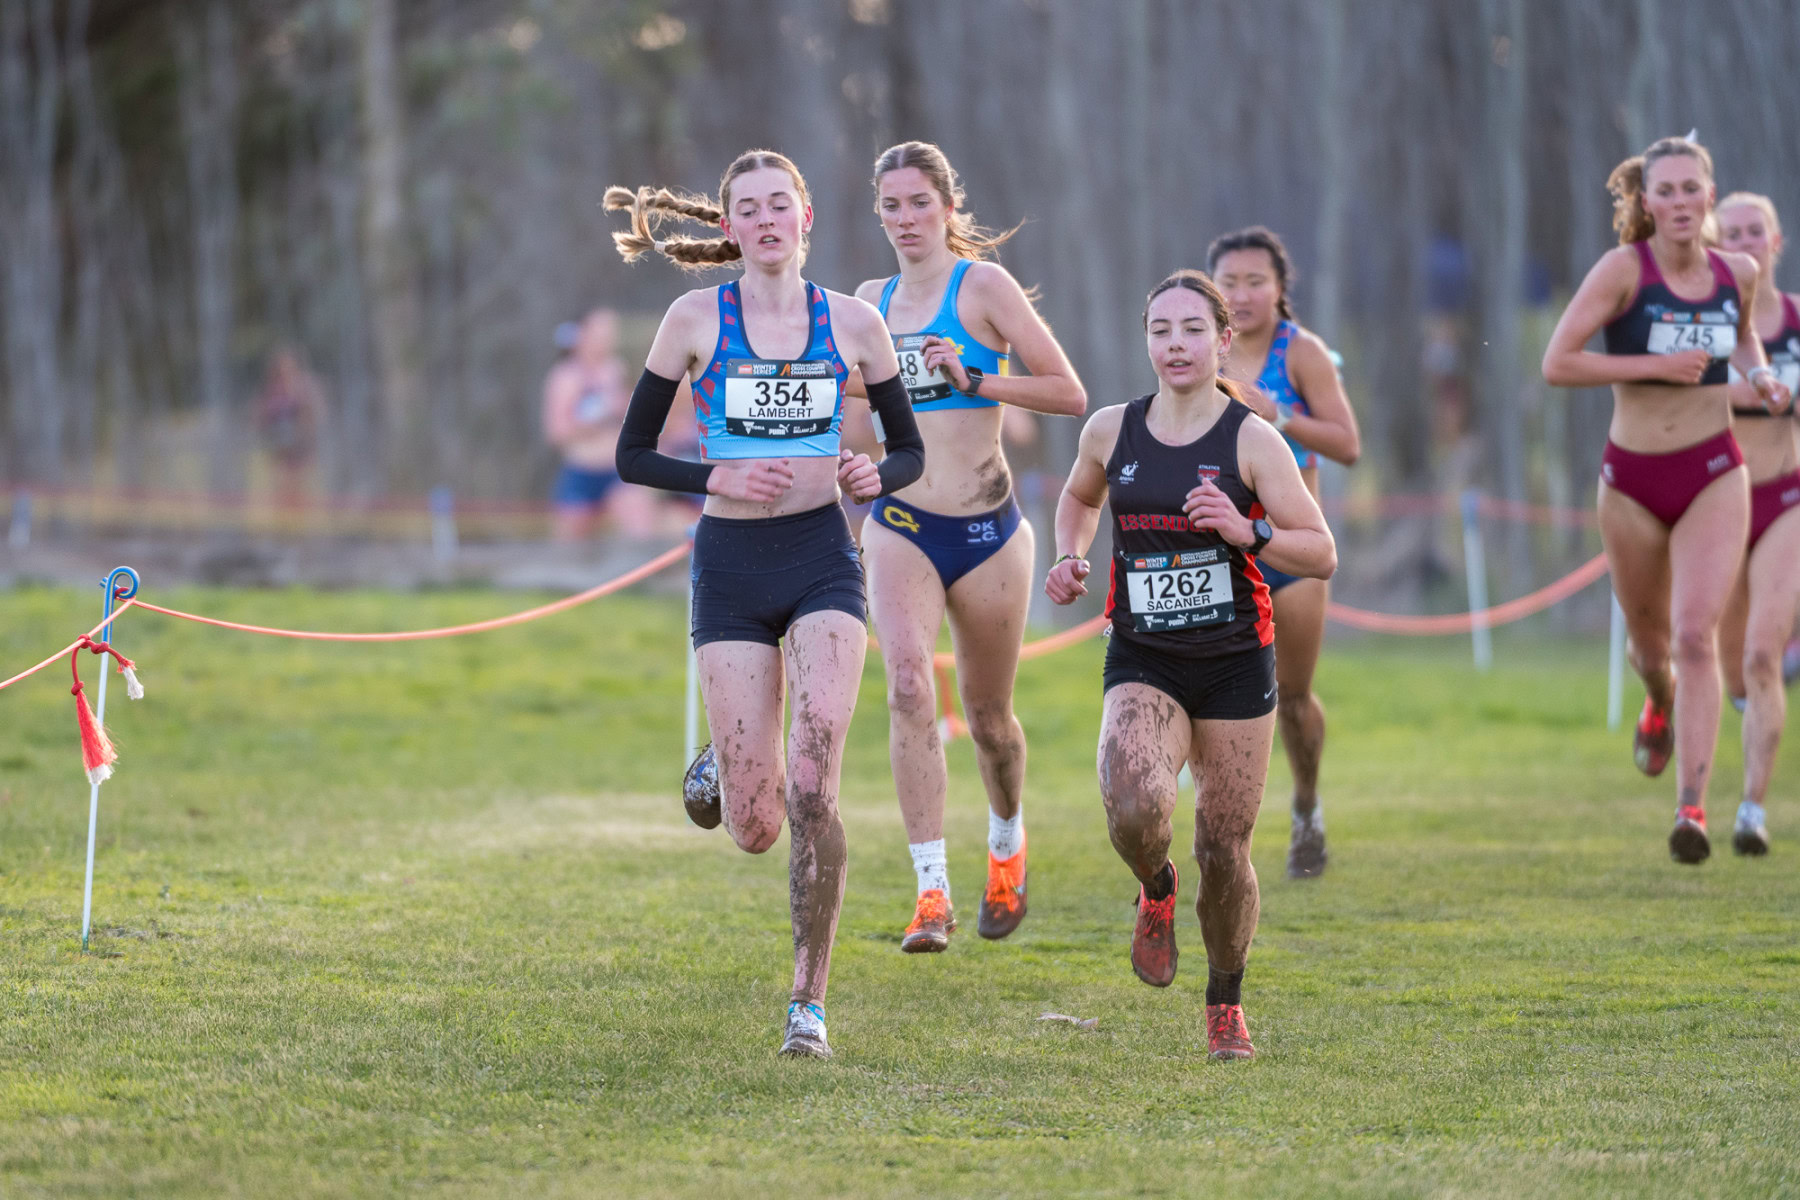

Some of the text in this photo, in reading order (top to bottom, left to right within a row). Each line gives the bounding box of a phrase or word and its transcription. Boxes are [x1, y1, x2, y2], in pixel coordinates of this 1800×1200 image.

[1673, 326, 1713, 347] 745
[755, 381, 809, 407] 354
[748, 407, 814, 418] LAMBERT
[968, 521, 994, 533] OK
[1118, 514, 1215, 533] ESSENDO
[1143, 569, 1213, 600] 1262
[1147, 594, 1211, 611] SACANER
[1168, 618, 1185, 627] PUMA
